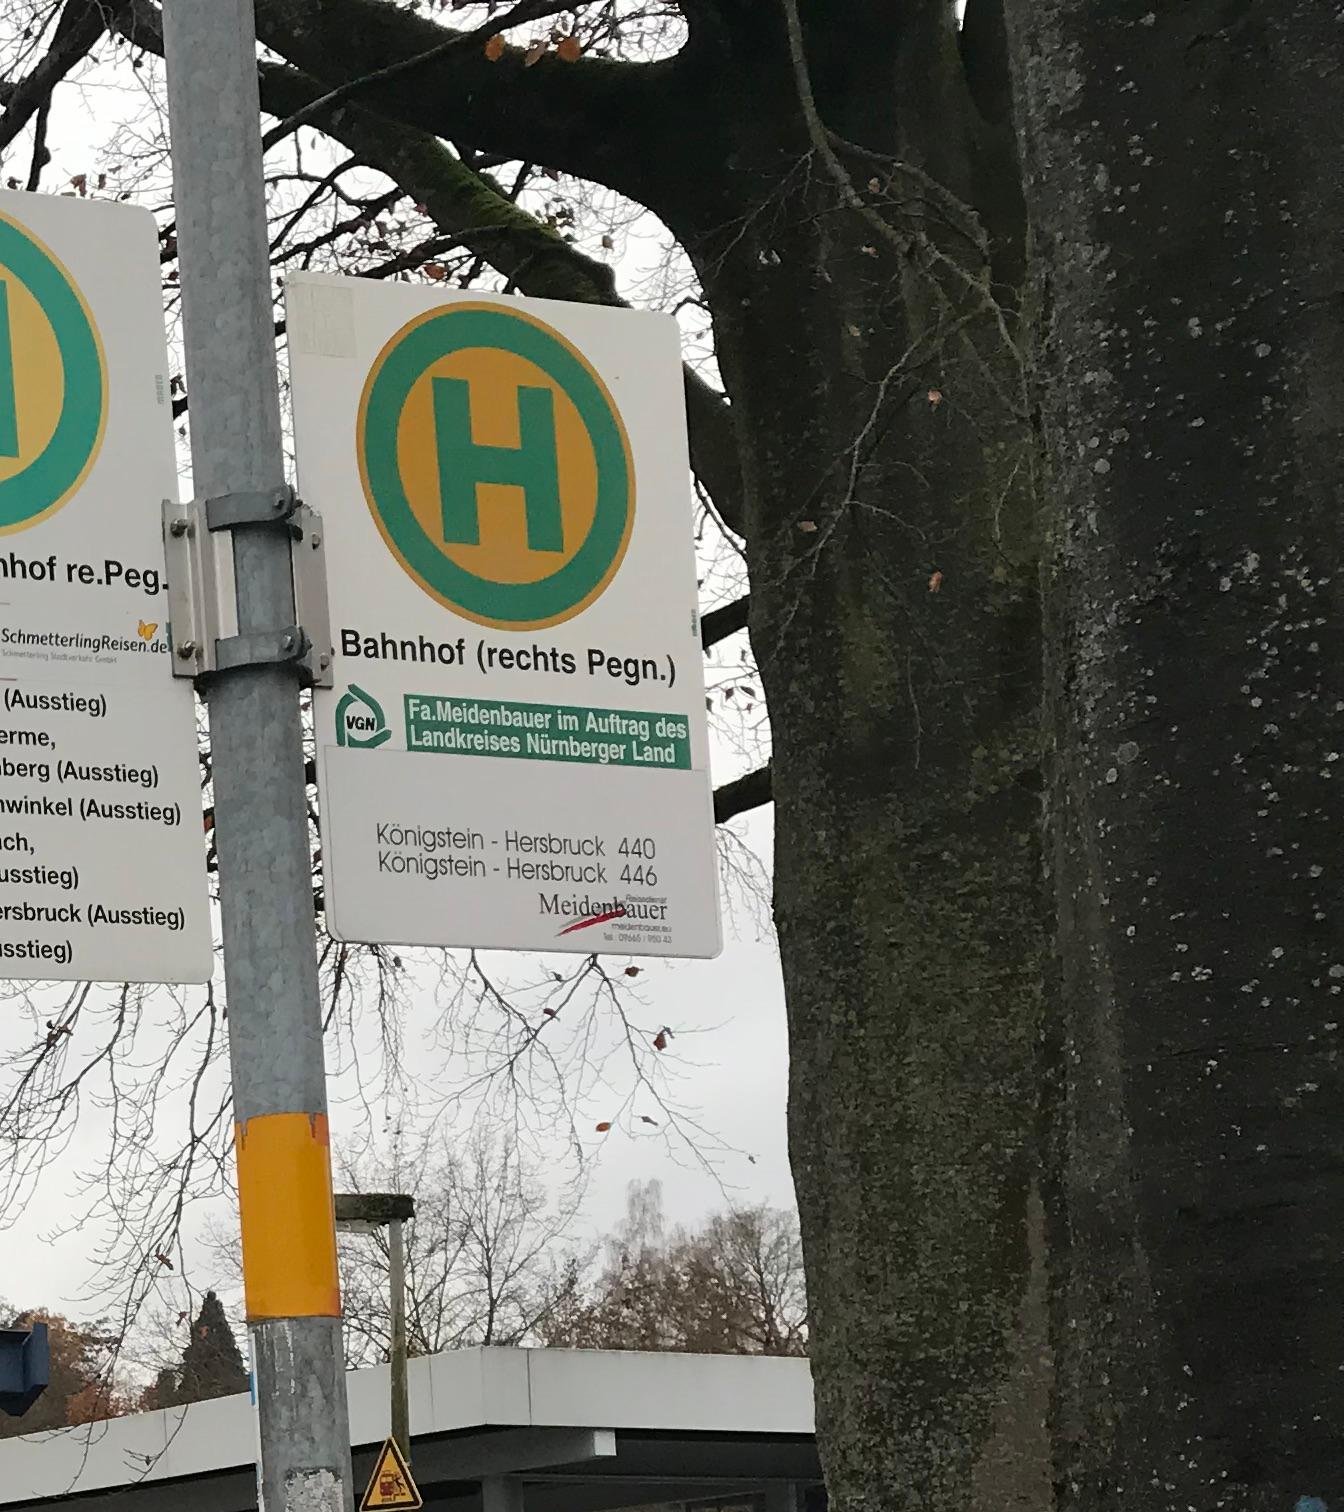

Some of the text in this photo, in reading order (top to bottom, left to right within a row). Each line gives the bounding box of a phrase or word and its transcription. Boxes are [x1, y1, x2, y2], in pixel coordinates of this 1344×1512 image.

[432, 376, 564, 553] H
[1, 627, 167, 654] SchmetterlingReisen.de
[341, 629, 676, 687] Bahnhof (rechts Pegn.)
[4, 689, 107, 717] (Ausstieg)
[346, 715, 375, 731] VGN
[557, 711, 578, 731] im
[585, 712, 650, 739] Auftrag
[656, 717, 686, 739] des
[410, 725, 675, 764] Landkreises Nürnberger Land
[57, 760, 158, 788] (Ausstieg)
[80, 798, 181, 826] (Ausstieg)
[377, 823, 484, 853] Königstein
[505, 830, 605, 858] Hersbruck
[618, 838, 655, 860] 440
[378, 851, 485, 880] Königstein
[507, 858, 607, 884] Hersbruck
[620, 865, 657, 886] 446
[87, 904, 185, 930] (Ausstieg)
[538, 893, 668, 920] Meidenbauer
